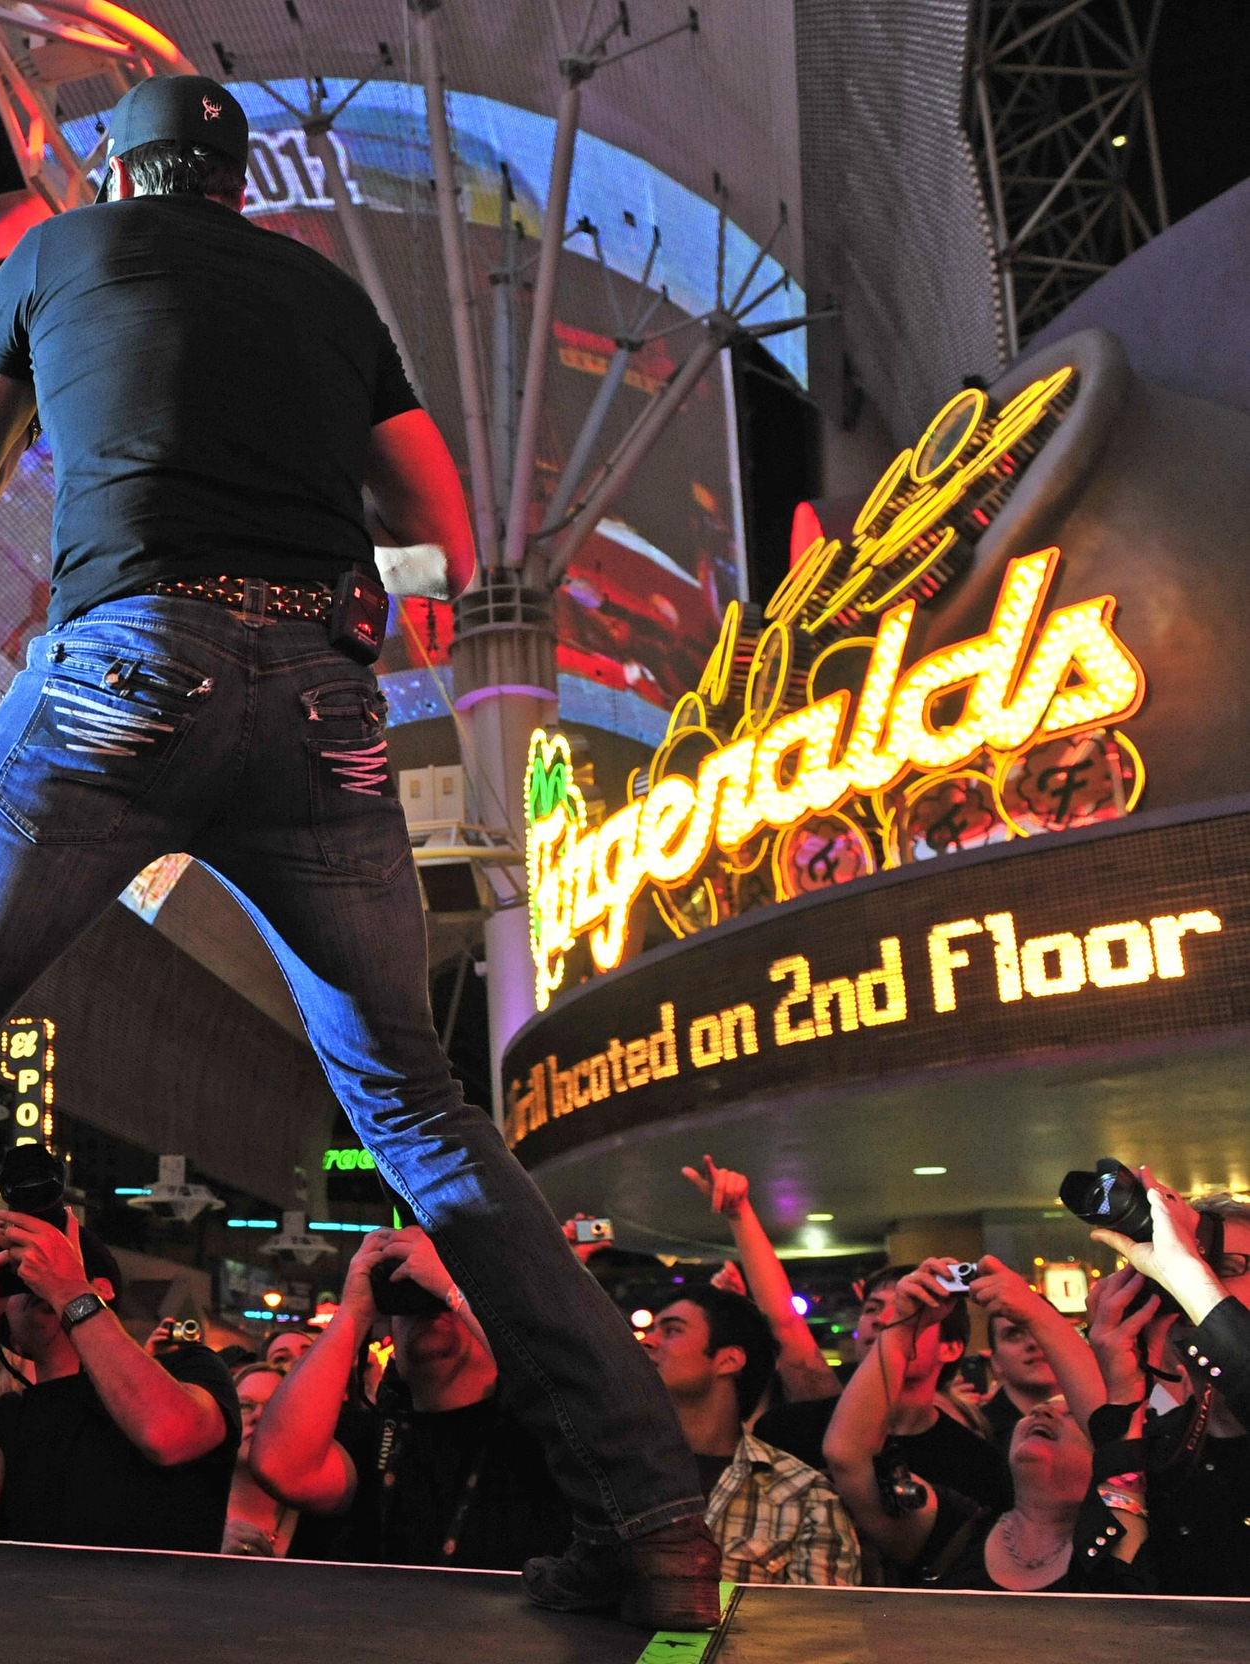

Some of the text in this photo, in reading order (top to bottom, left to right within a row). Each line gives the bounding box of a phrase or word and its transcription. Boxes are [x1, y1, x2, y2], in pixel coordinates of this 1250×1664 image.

[689, 1003, 759, 1068] on
[770, 935, 907, 1046] 2nd
[928, 910, 1222, 1013] Floor
[10, 1030, 38, 1059] El
[377, 1419, 397, 1470] Canon
